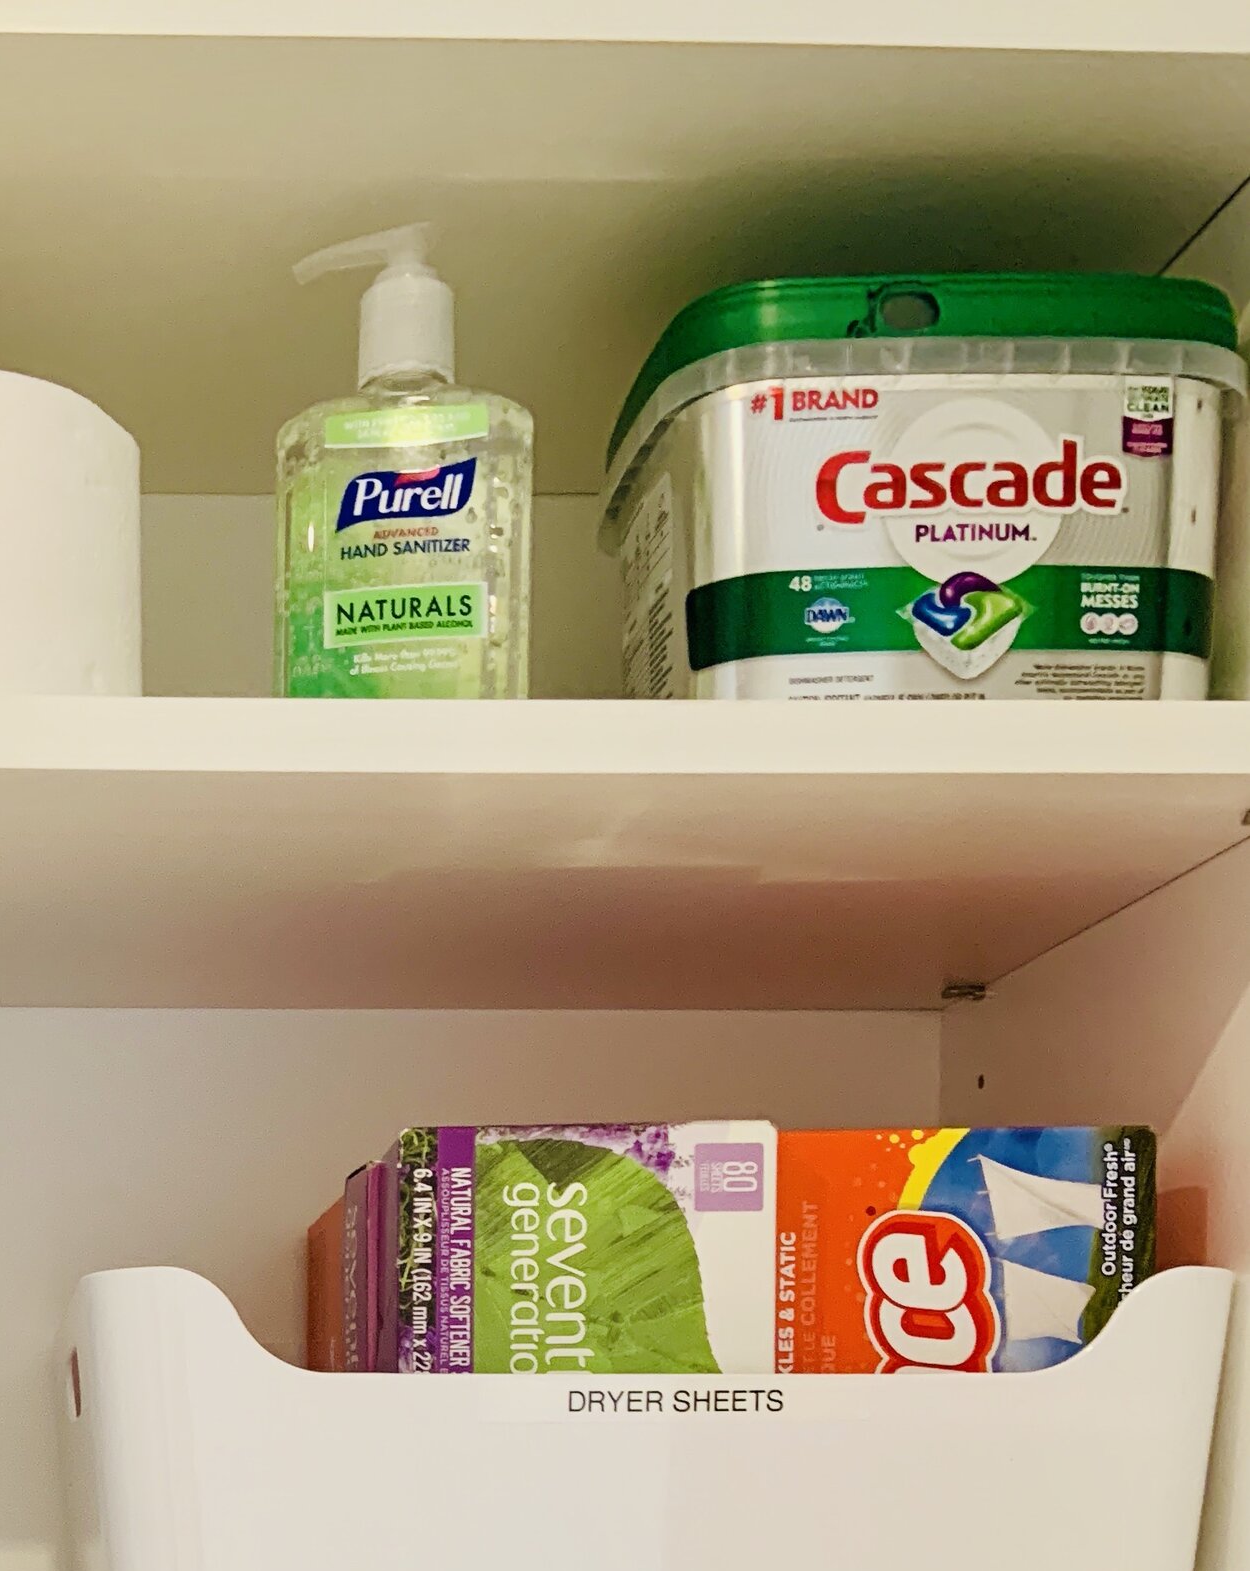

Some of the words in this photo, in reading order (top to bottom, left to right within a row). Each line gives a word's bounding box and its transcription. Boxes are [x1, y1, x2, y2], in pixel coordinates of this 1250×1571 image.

[751, 387, 784, 420] #1
[792, 388, 879, 411] BRAND
[352, 473, 463, 516] Purell
[816, 440, 1123, 524] Cascade
[373, 526, 440, 539] ADVANCED
[341, 543, 388, 560] HAND
[393, 538, 470, 556] SANITIZER
[788, 575, 812, 592] 48
[1080, 582, 1140, 593] BURNT-ON
[336, 594, 473, 625] NATURALS
[807, 608, 847, 622] DAWN
[1080, 594, 1139, 609] MESSES
[412, 1167, 433, 1192] 6.4
[722, 1161, 759, 1193] 80
[412, 1197, 432, 1216] IN
[440, 1168, 450, 1256] ASSOUPLISSEUR
[450, 1167, 472, 1234] NATURAL
[1120, 1176, 1138, 1225] grand
[413, 1232, 432, 1243] 9
[1101, 1204, 1117, 1276] Outdoor
[1119, 1230, 1134, 1252] de
[412, 1247, 432, 1264] IN
[440, 1261, 449, 1273] DE
[450, 1239, 472, 1291] FABRIC
[778, 1232, 797, 1302] STATIC
[801, 1200, 819, 1326] COLLEMENT
[411, 1268, 432, 1300] (162
[544, 1182, 596, 1373] sevent
[440, 1276, 449, 1312] TISSUS
[862, 1218, 994, 1373] ce
[412, 1306, 428, 1335] mm
[778, 1305, 795, 1321] &
[412, 1338, 427, 1347] x
[439, 1315, 448, 1364] NATUREL
[449, 1295, 471, 1367] SOFTENER
[568, 1390, 664, 1412] DRYER
[672, 1388, 784, 1412] SHEETS
